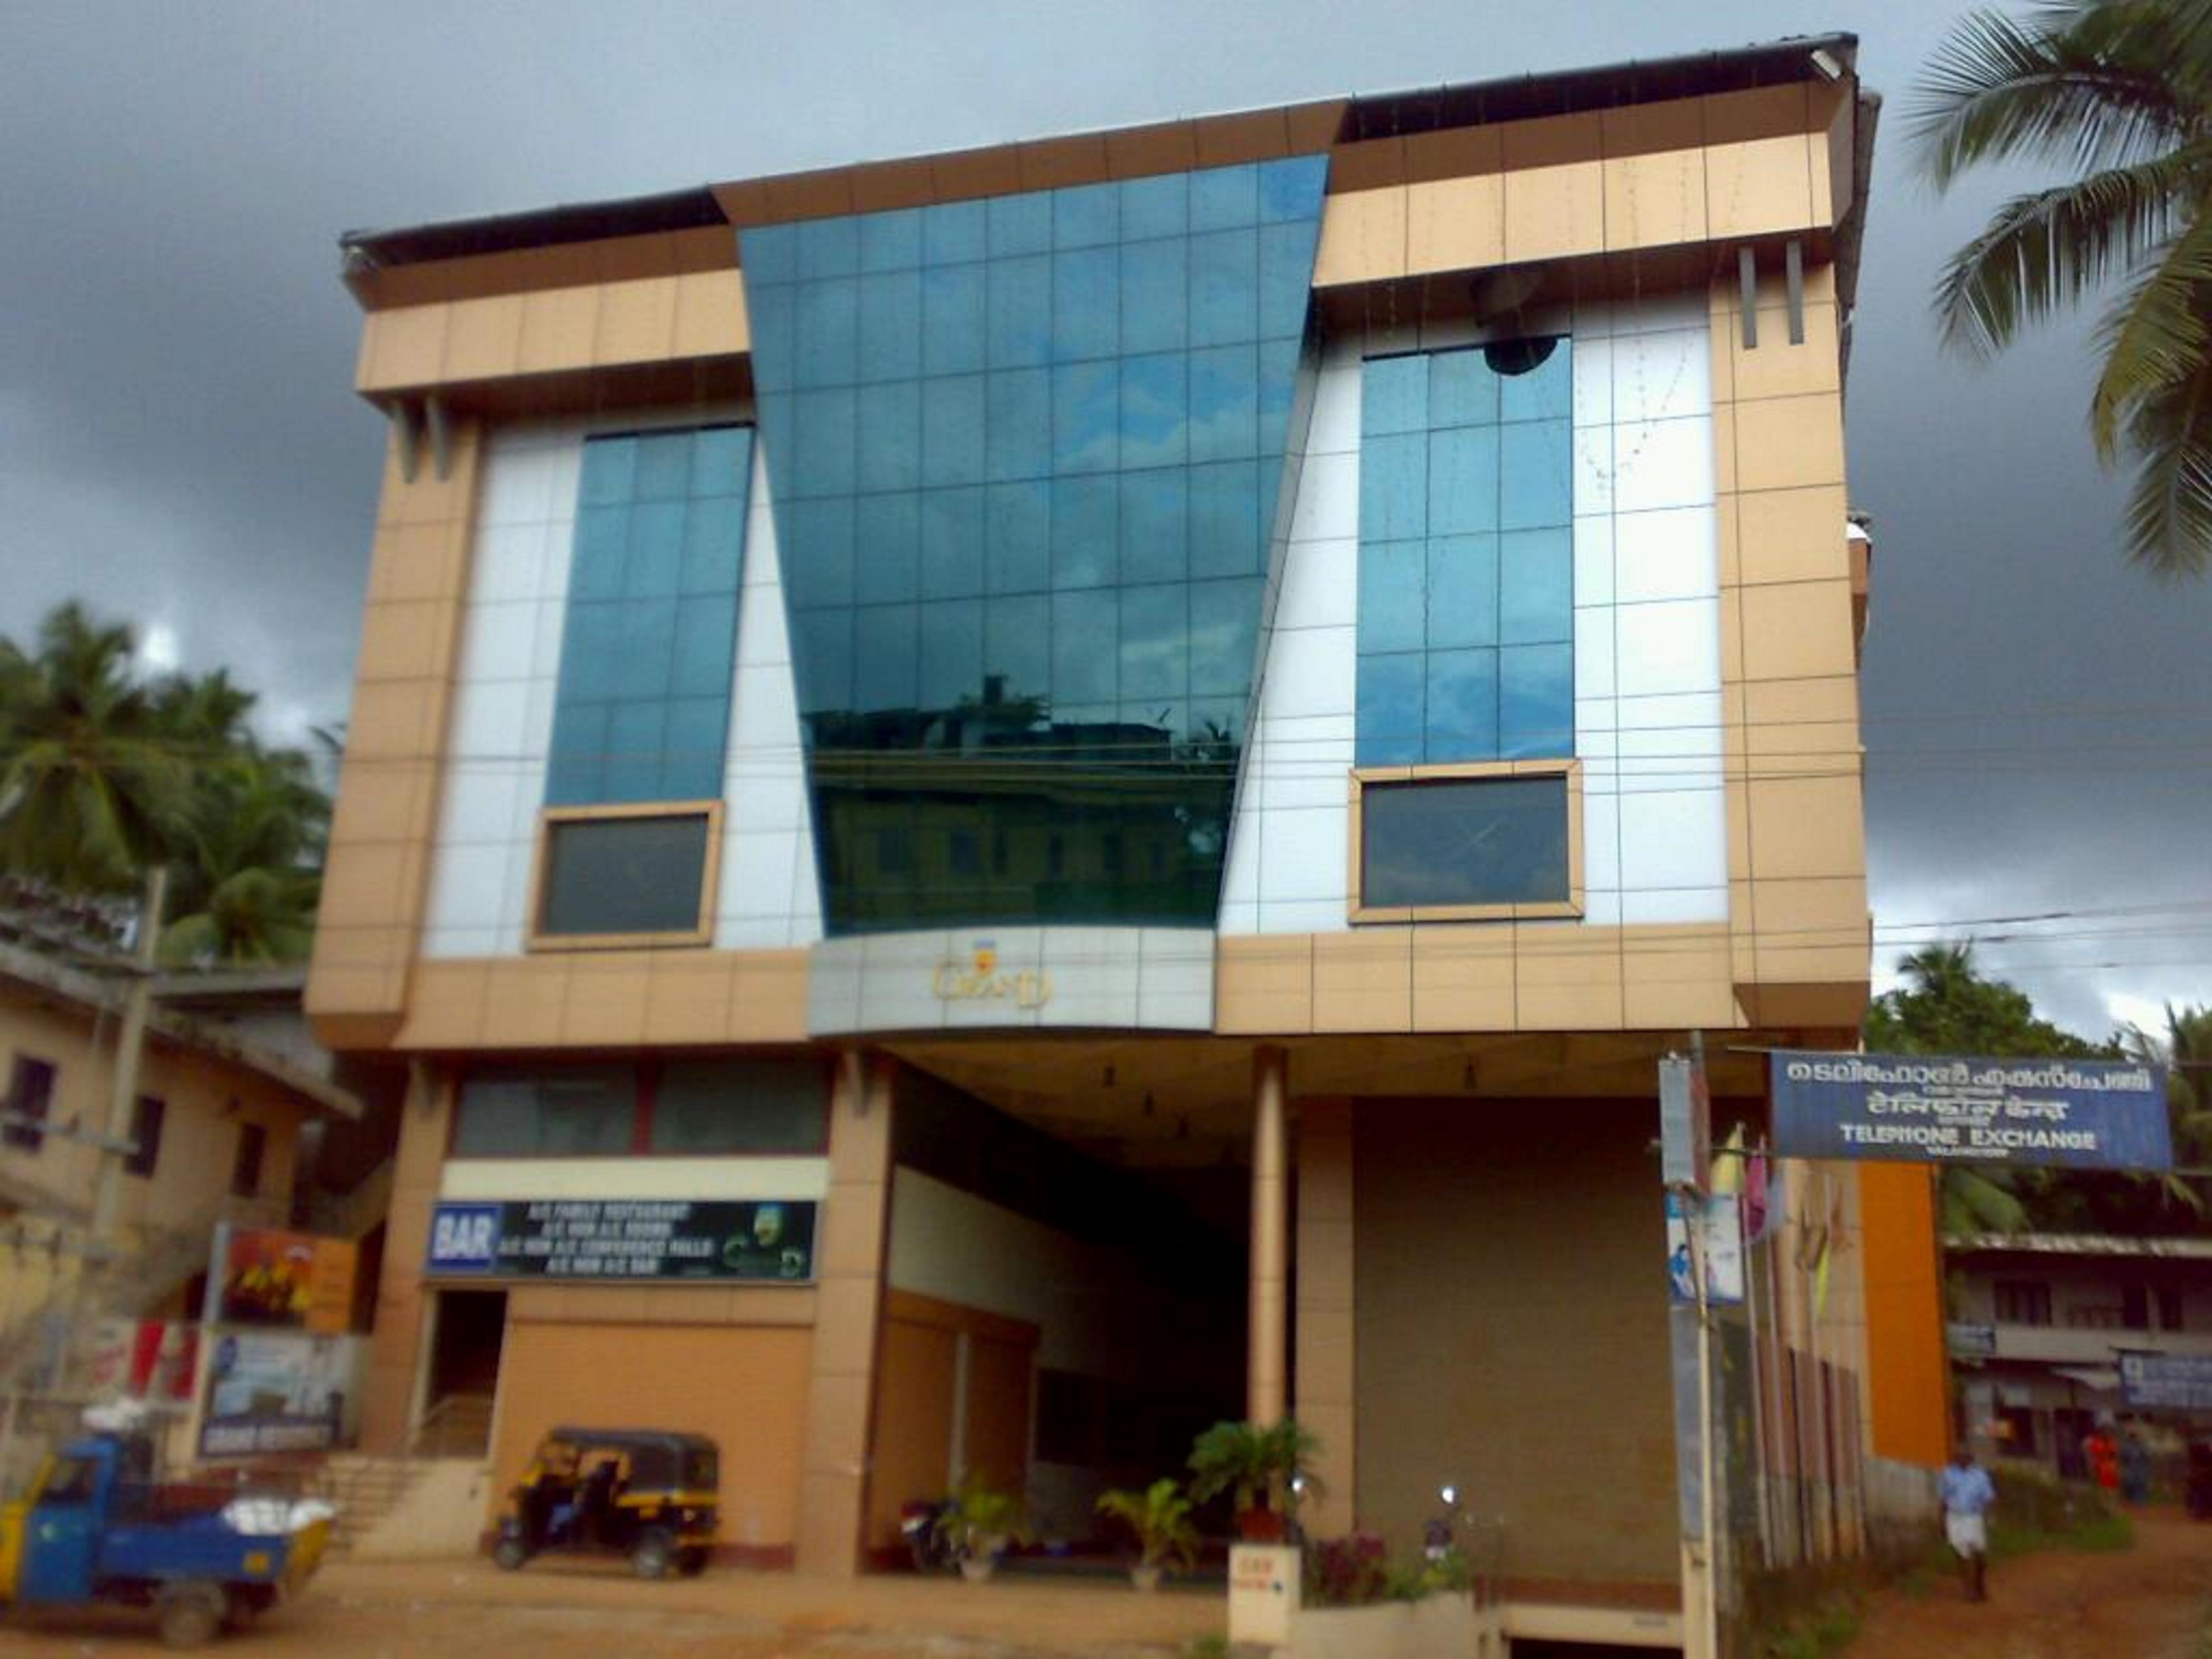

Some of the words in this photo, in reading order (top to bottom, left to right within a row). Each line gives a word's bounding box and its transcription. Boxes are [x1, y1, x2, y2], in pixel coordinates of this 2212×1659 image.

[1840, 1123, 1960, 1146] TELEPHONE
[1970, 1128, 2097, 1151] EXCHANGE
[431, 1213, 494, 1260] BAR
